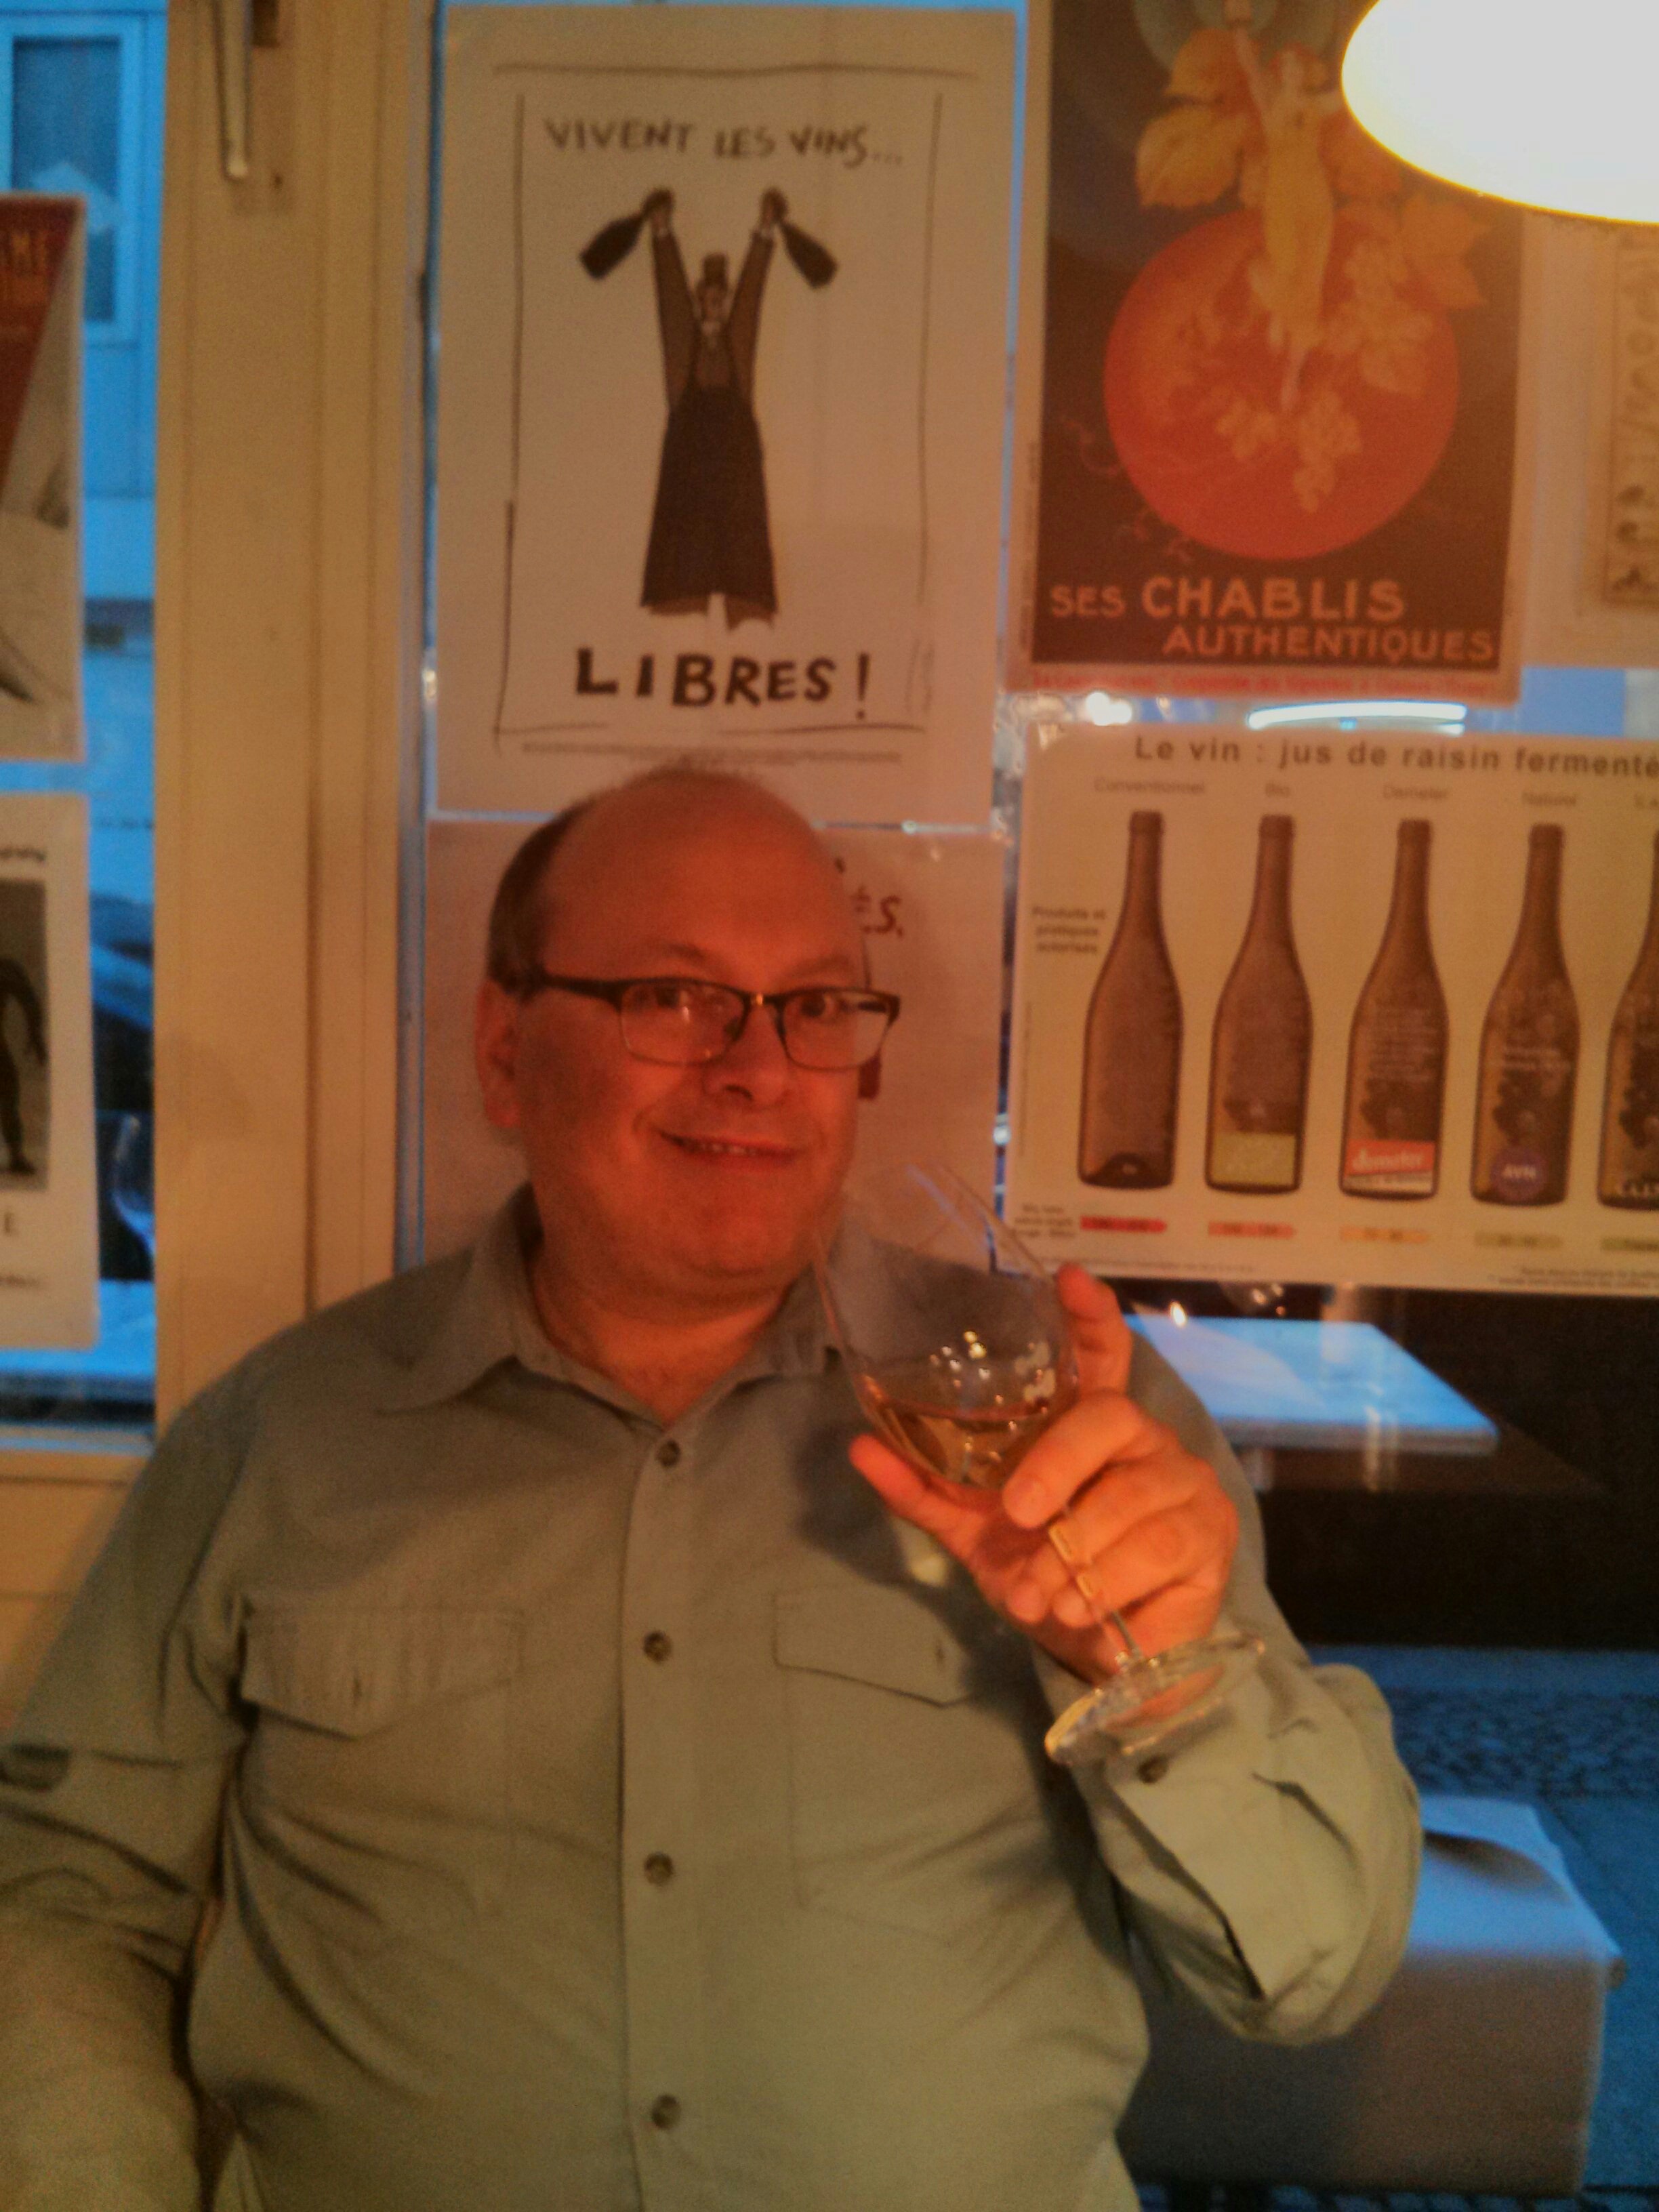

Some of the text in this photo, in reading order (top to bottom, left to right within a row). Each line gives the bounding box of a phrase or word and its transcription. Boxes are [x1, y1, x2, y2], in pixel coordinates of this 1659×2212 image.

[542, 117, 694, 152] VIVENT
[713, 126, 777, 159] LES
[1050, 575, 1405, 623] SES CHABLIS
[1162, 625, 1492, 663] AUTHENTIQUES
[1134, 735, 1175, 761] Le
[1189, 737, 1241, 762] vin
[1277, 737, 1332, 771] jus
[1347, 741, 1387, 767] de
[1402, 743, 1500, 771] raisin
